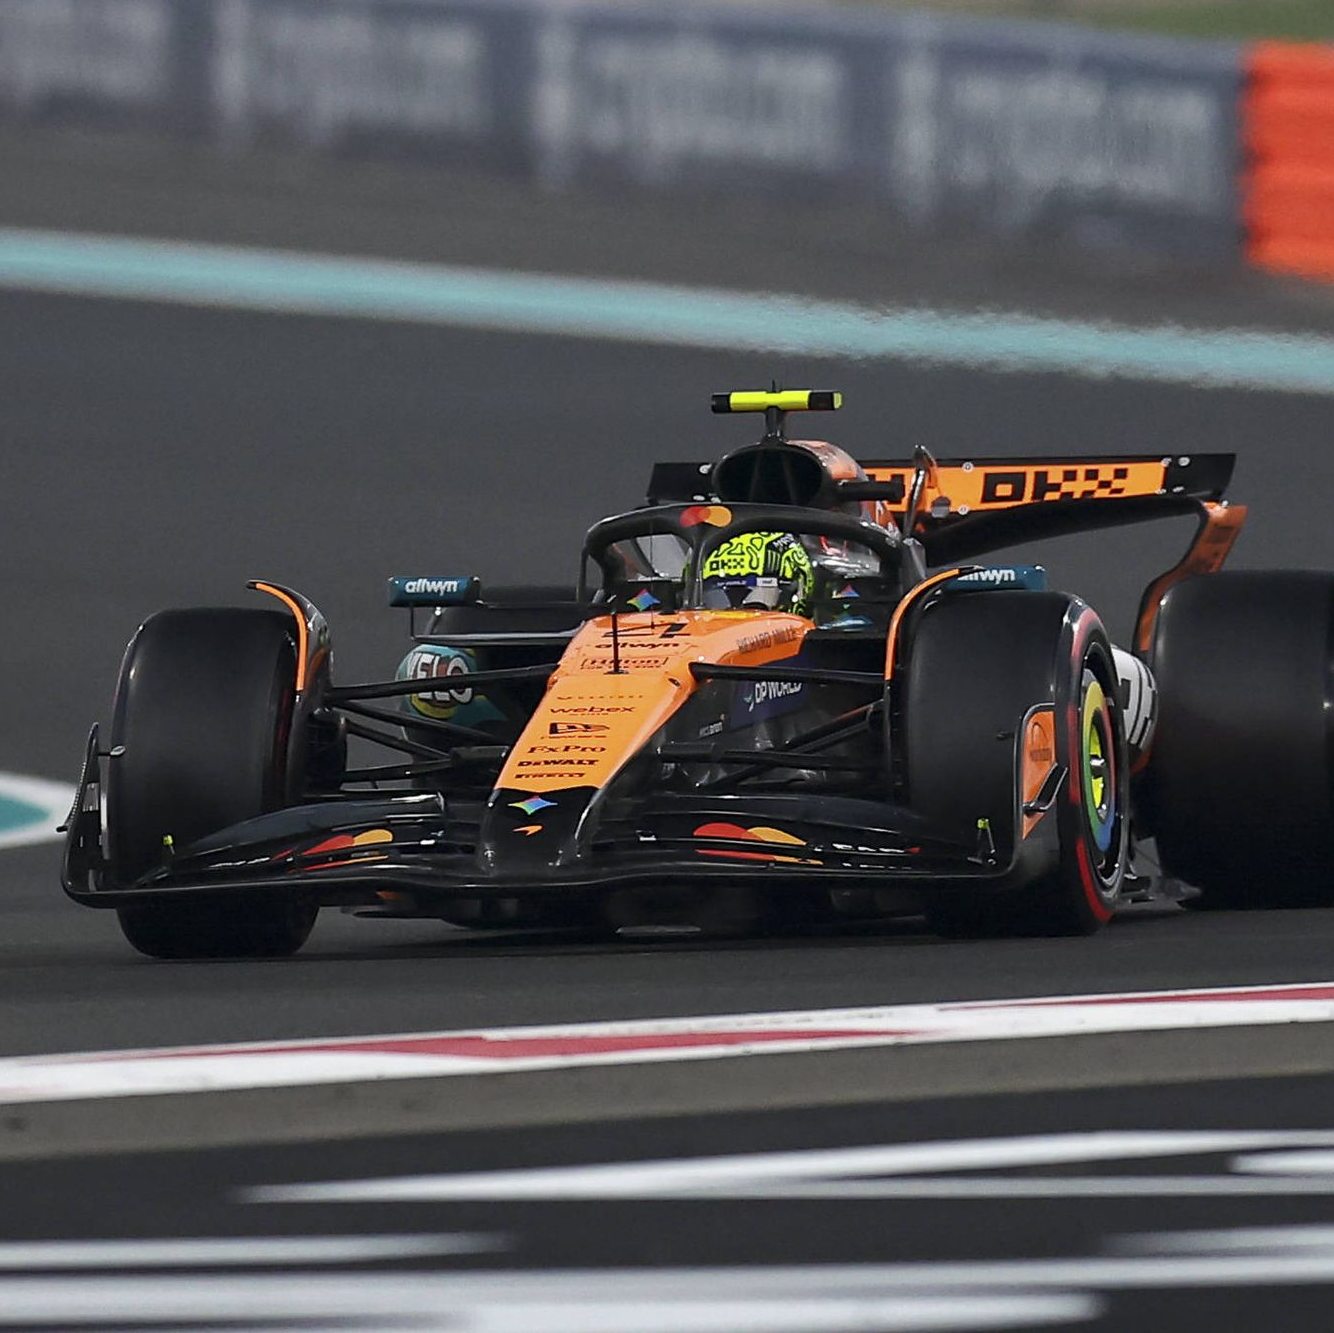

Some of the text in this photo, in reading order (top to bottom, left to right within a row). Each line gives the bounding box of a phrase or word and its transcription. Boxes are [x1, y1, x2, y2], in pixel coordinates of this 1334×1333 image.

[981, 468, 1129, 505] OKX
[404, 577, 459, 596] allwyn
[549, 706, 636, 714] webex
